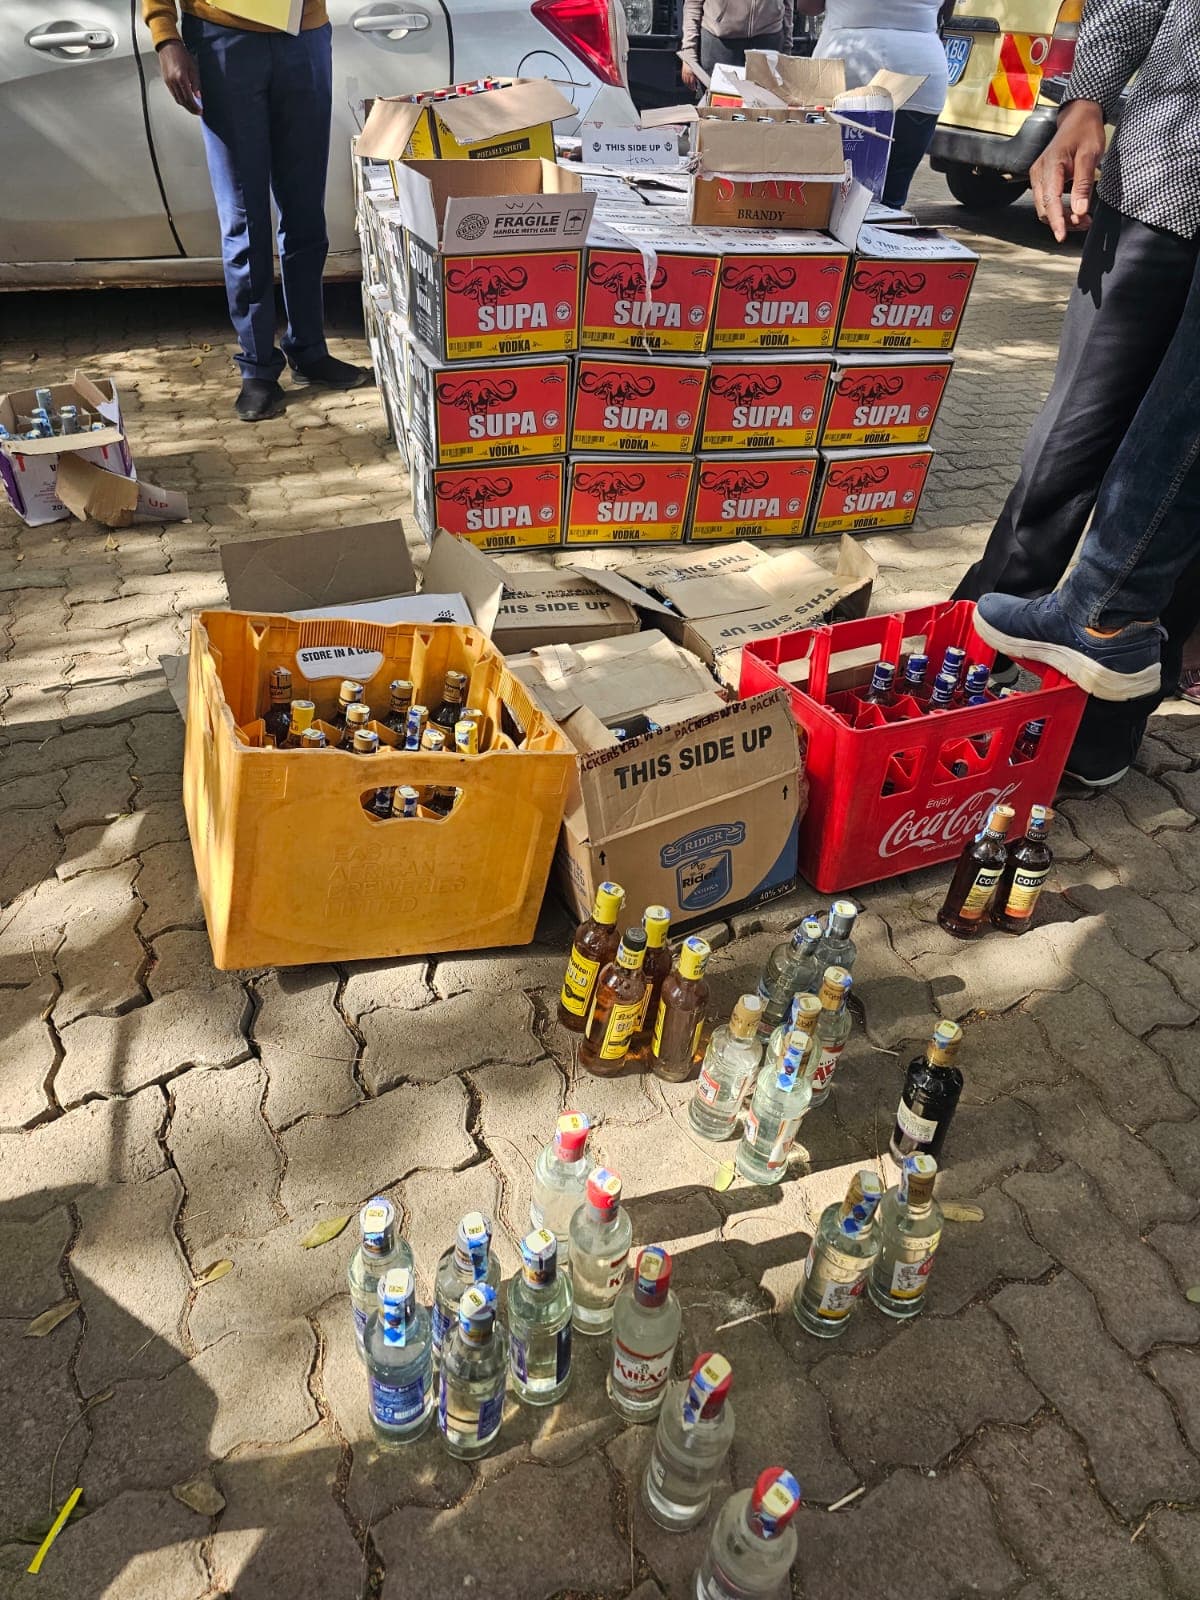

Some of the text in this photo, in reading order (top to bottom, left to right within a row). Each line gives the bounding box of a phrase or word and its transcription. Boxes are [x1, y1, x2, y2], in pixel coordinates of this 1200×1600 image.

[605, 144, 661, 152] THIS SIDE UP
[494, 215, 560, 228] FRAGILE
[737, 208, 787, 222] BRANDY
[478, 302, 549, 332] SUPA
[614, 300, 681, 328] SUPA
[744, 300, 809, 325] SUPA
[870, 304, 934, 327] SUPA
[499, 339, 530, 353] VODKA
[760, 334, 790, 346] VODKA
[882, 336, 912, 347] VODKA
[603, 406, 668, 431] SUPA
[732, 405, 794, 428] SUPA
[852, 404, 911, 426] SUPA
[468, 410, 538, 438] SUPA
[619, 439, 649, 450] VODKA
[746, 436, 775, 447] VODKA
[864, 433, 890, 444] VODKA
[488, 444, 520, 458] VODKA
[149, 498, 168, 510] UP
[721, 498, 780, 520] SUPA
[842, 490, 897, 514] SUPA
[466, 505, 533, 530] SUPA
[596, 500, 658, 523] SUPA
[735, 526, 762, 536] VODKA
[854, 518, 878, 528] VODKA
[486, 536, 516, 547] VODKA
[612, 530, 640, 540] VODKA
[708, 554, 749, 569] THIS
[498, 602, 611, 614] HIS SIDE UP
[794, 587, 839, 614] THIS
[748, 614, 792, 632] SIDE
[720, 627, 746, 638] UP
[302, 650, 332, 662] STORE
[334, 648, 345, 658] IN
[348, 648, 355, 656] A
[750, 694, 781, 714] PACKE
[580, 749, 620, 773] ACKERS
[614, 725, 772, 790] THIS SIDE UP
[926, 796, 953, 808] Enjoy
[878, 781, 1022, 858] Coca-Col
[685, 831, 724, 851] RIDER
[682, 870, 717, 888] Rider
[760, 888, 776, 901] 40%
[616, 1359, 668, 1382] KIBAO
